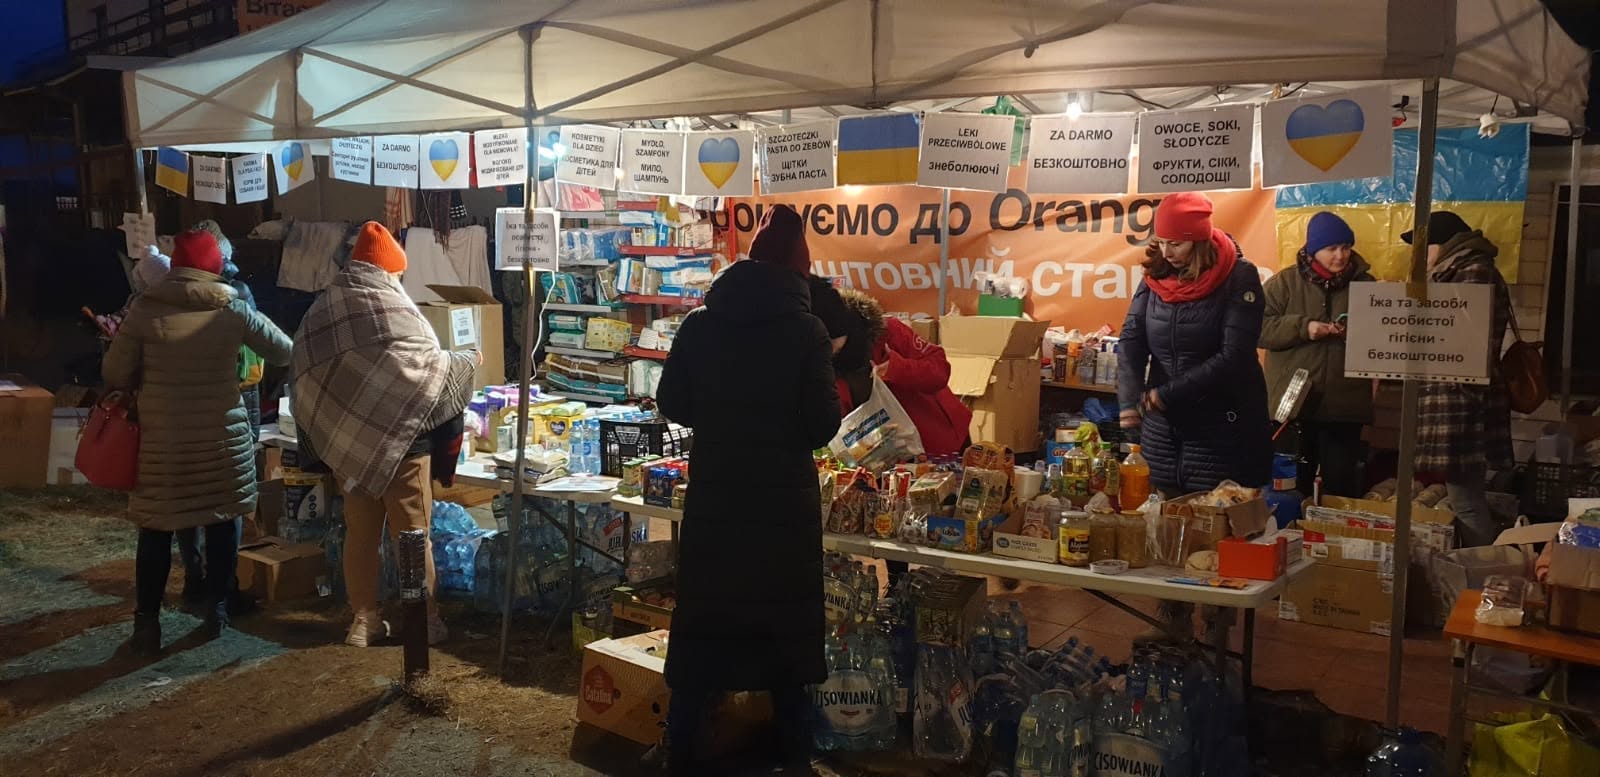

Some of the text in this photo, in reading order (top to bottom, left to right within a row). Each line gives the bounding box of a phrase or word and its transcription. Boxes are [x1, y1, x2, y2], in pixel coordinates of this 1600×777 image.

[246, 0, 300, 17] Віта
[958, 128, 979, 138] LEKI
[1154, 120, 1241, 135] OWOCE, SOKI,
[571, 132, 606, 143] KOSMETYKI
[768, 131, 819, 145] SZCZOTECZKI
[1050, 129, 1113, 141] ZA DARMO
[573, 142, 605, 152] DLA DZIECI
[641, 139, 664, 148] MYDŁO,
[928, 138, 1007, 151] PRZECIWBÓLOWE
[1163, 135, 1230, 148] SŁODYCZE
[390, 144, 411, 152] DARMO
[635, 149, 670, 158] SZAMPONY
[766, 144, 789, 155] PASTA
[790, 143, 802, 153] DO
[376, 161, 417, 171] БЕЗКОШТОВНО
[600, 160, 615, 169] ДЛЯ
[641, 163, 663, 174] МИЛО,
[782, 159, 808, 170] ЩІТКИ
[928, 160, 1000, 176] знеболюючі
[1034, 158, 1127, 169] БЕЗКОШТОВНО
[1153, 157, 1240, 171] ФРУКТИ, СІКИ,
[576, 167, 597, 176] ДІТЕЙ
[770, 169, 828, 183] ЗУБНА ПАСТА
[1161, 171, 1231, 184] СОЛОДОЩІ
[634, 174, 670, 184] ШАМПУНЬ
[909, 201, 972, 244] до
[990, 188, 1162, 247] Orang
[1369, 294, 1468, 309] Їжа та засоби
[1381, 315, 1455, 327] особистої
[1388, 332, 1435, 344] гігієни
[1368, 349, 1464, 363] безкоштовно
